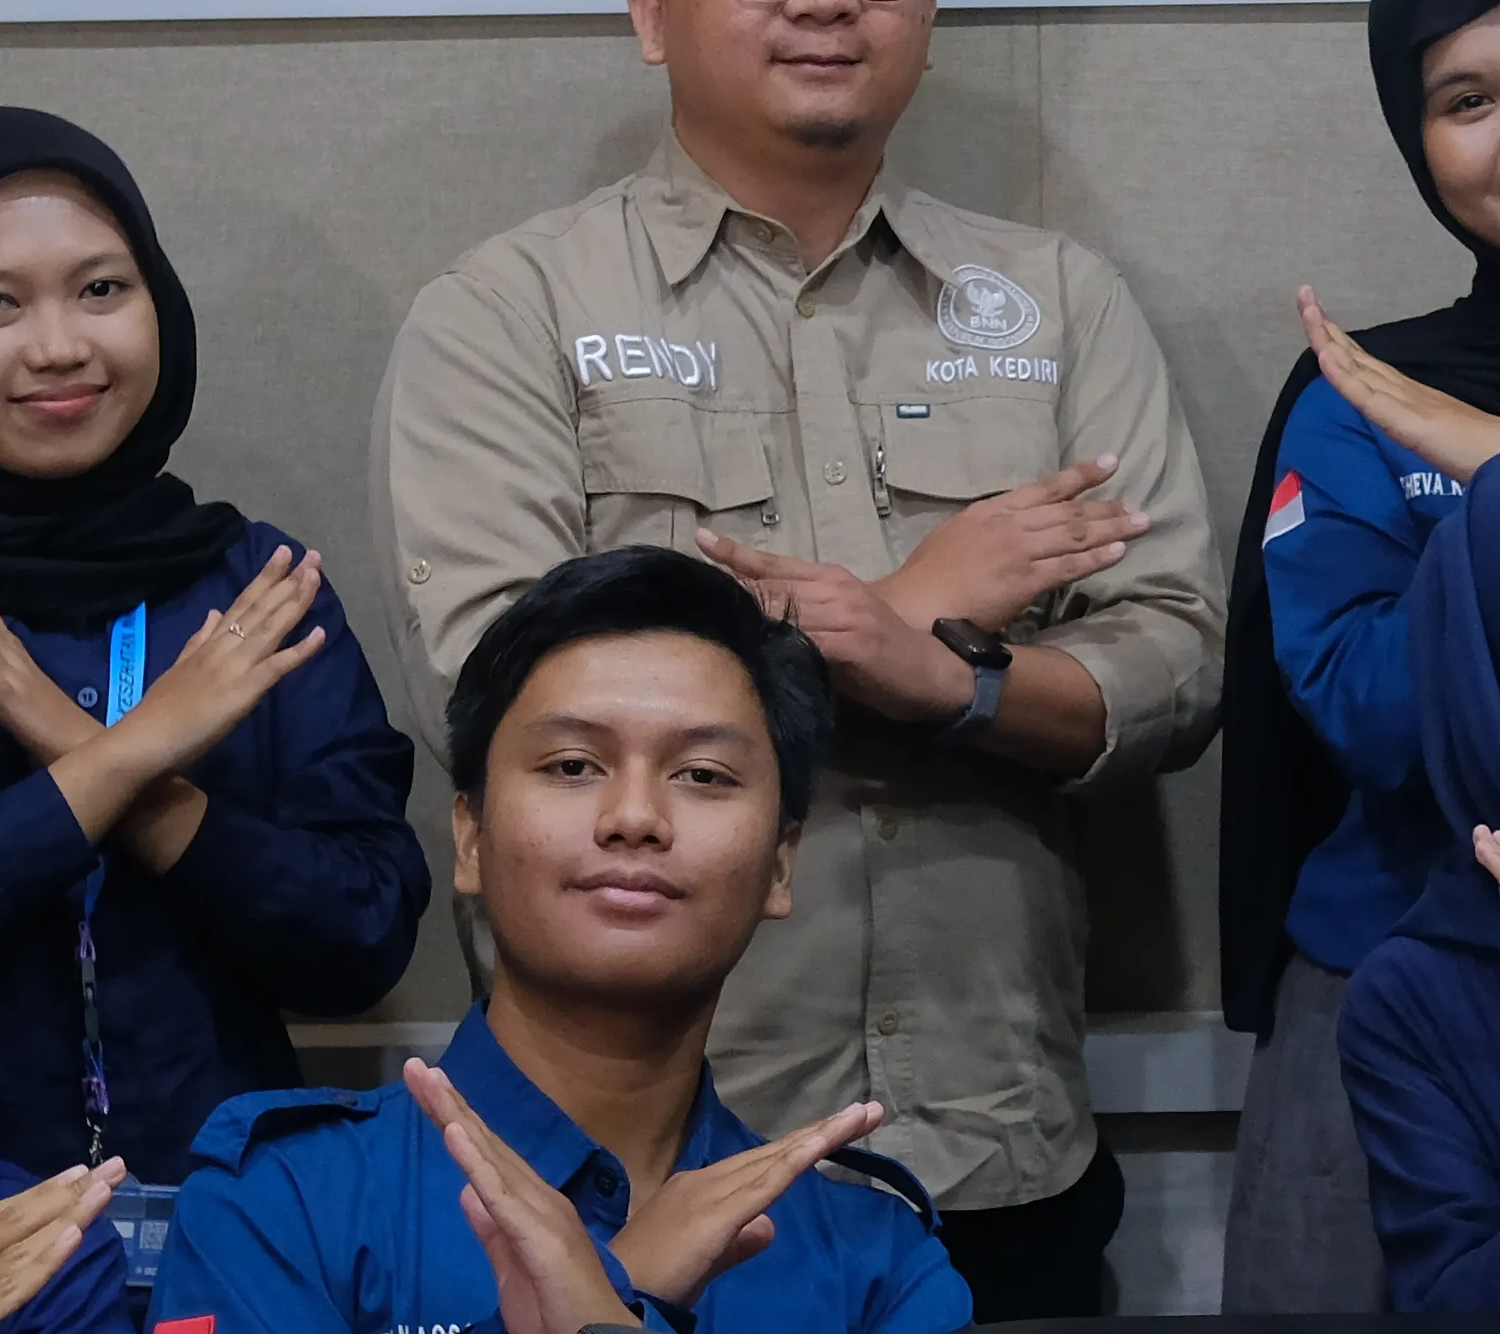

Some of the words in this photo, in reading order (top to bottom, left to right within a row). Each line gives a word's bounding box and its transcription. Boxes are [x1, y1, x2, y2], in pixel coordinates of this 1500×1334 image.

[575, 333, 717, 392] RENDY
[926, 355, 979, 383] KOTA
[989, 355, 1058, 385] KEDIRI
